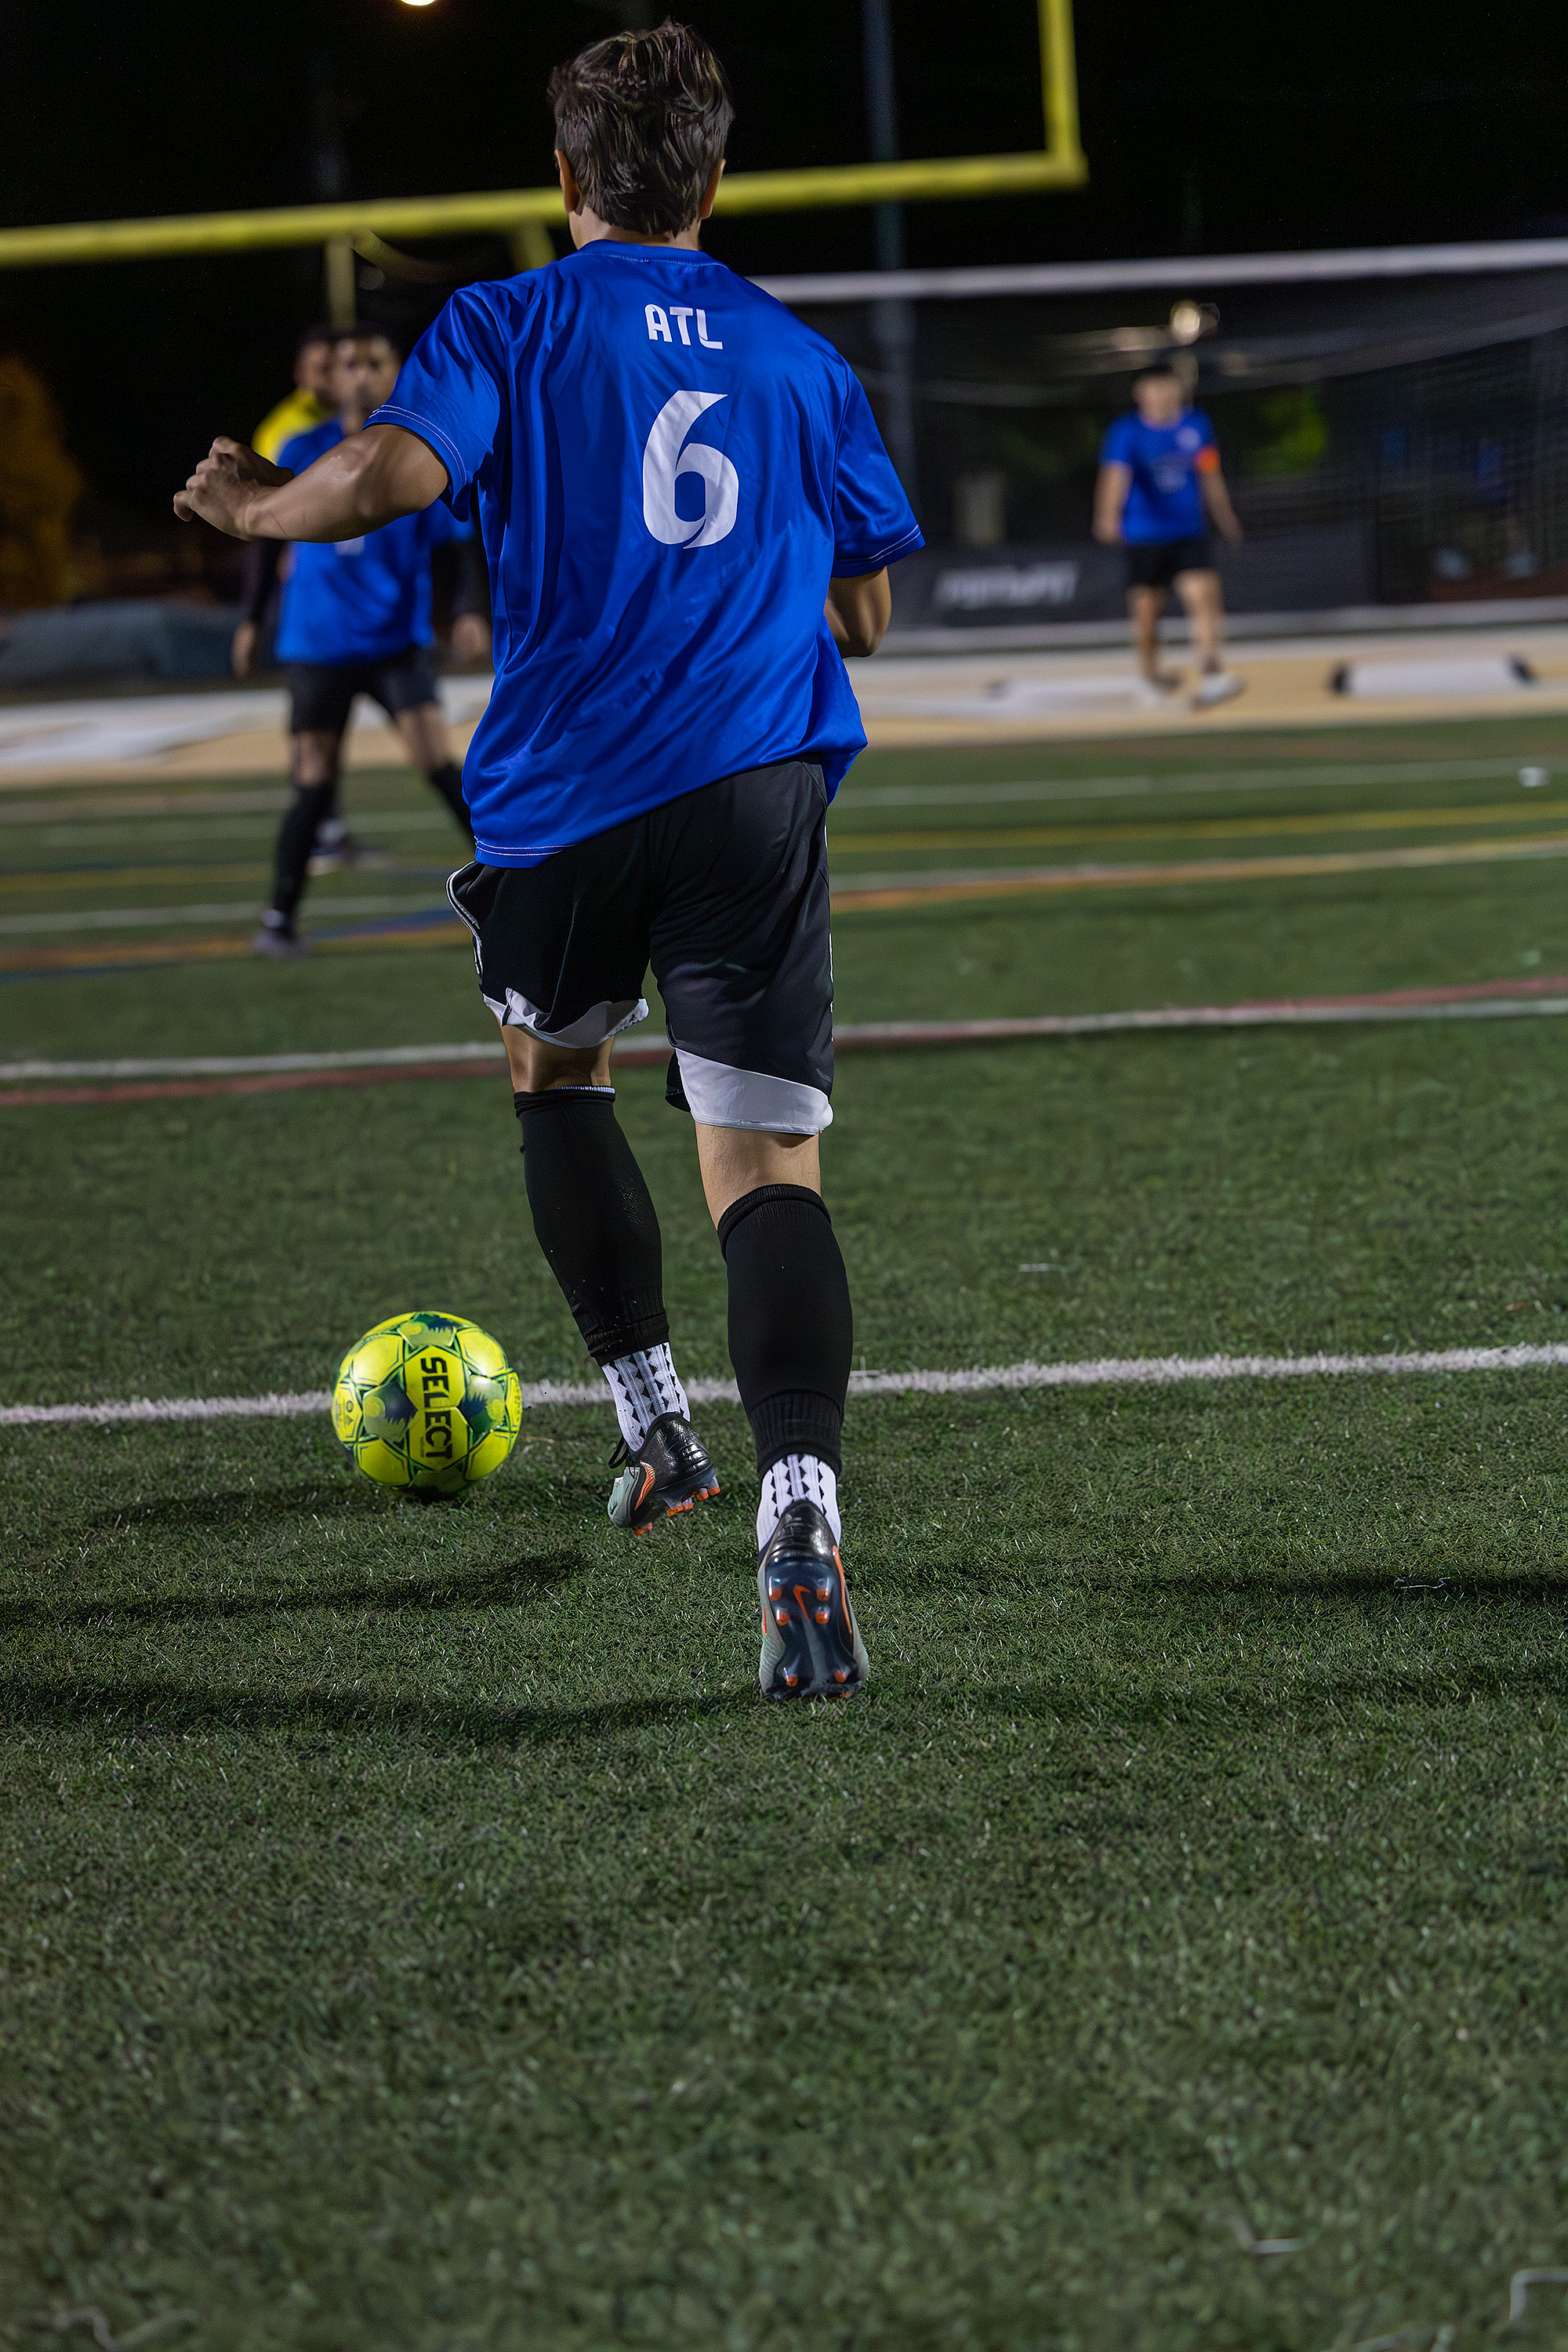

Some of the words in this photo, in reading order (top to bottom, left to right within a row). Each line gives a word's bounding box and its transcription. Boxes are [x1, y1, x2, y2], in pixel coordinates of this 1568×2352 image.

[644, 303, 724, 350] ATL
[643, 390, 739, 550] 6
[420, 1356, 453, 1459] SELECT
